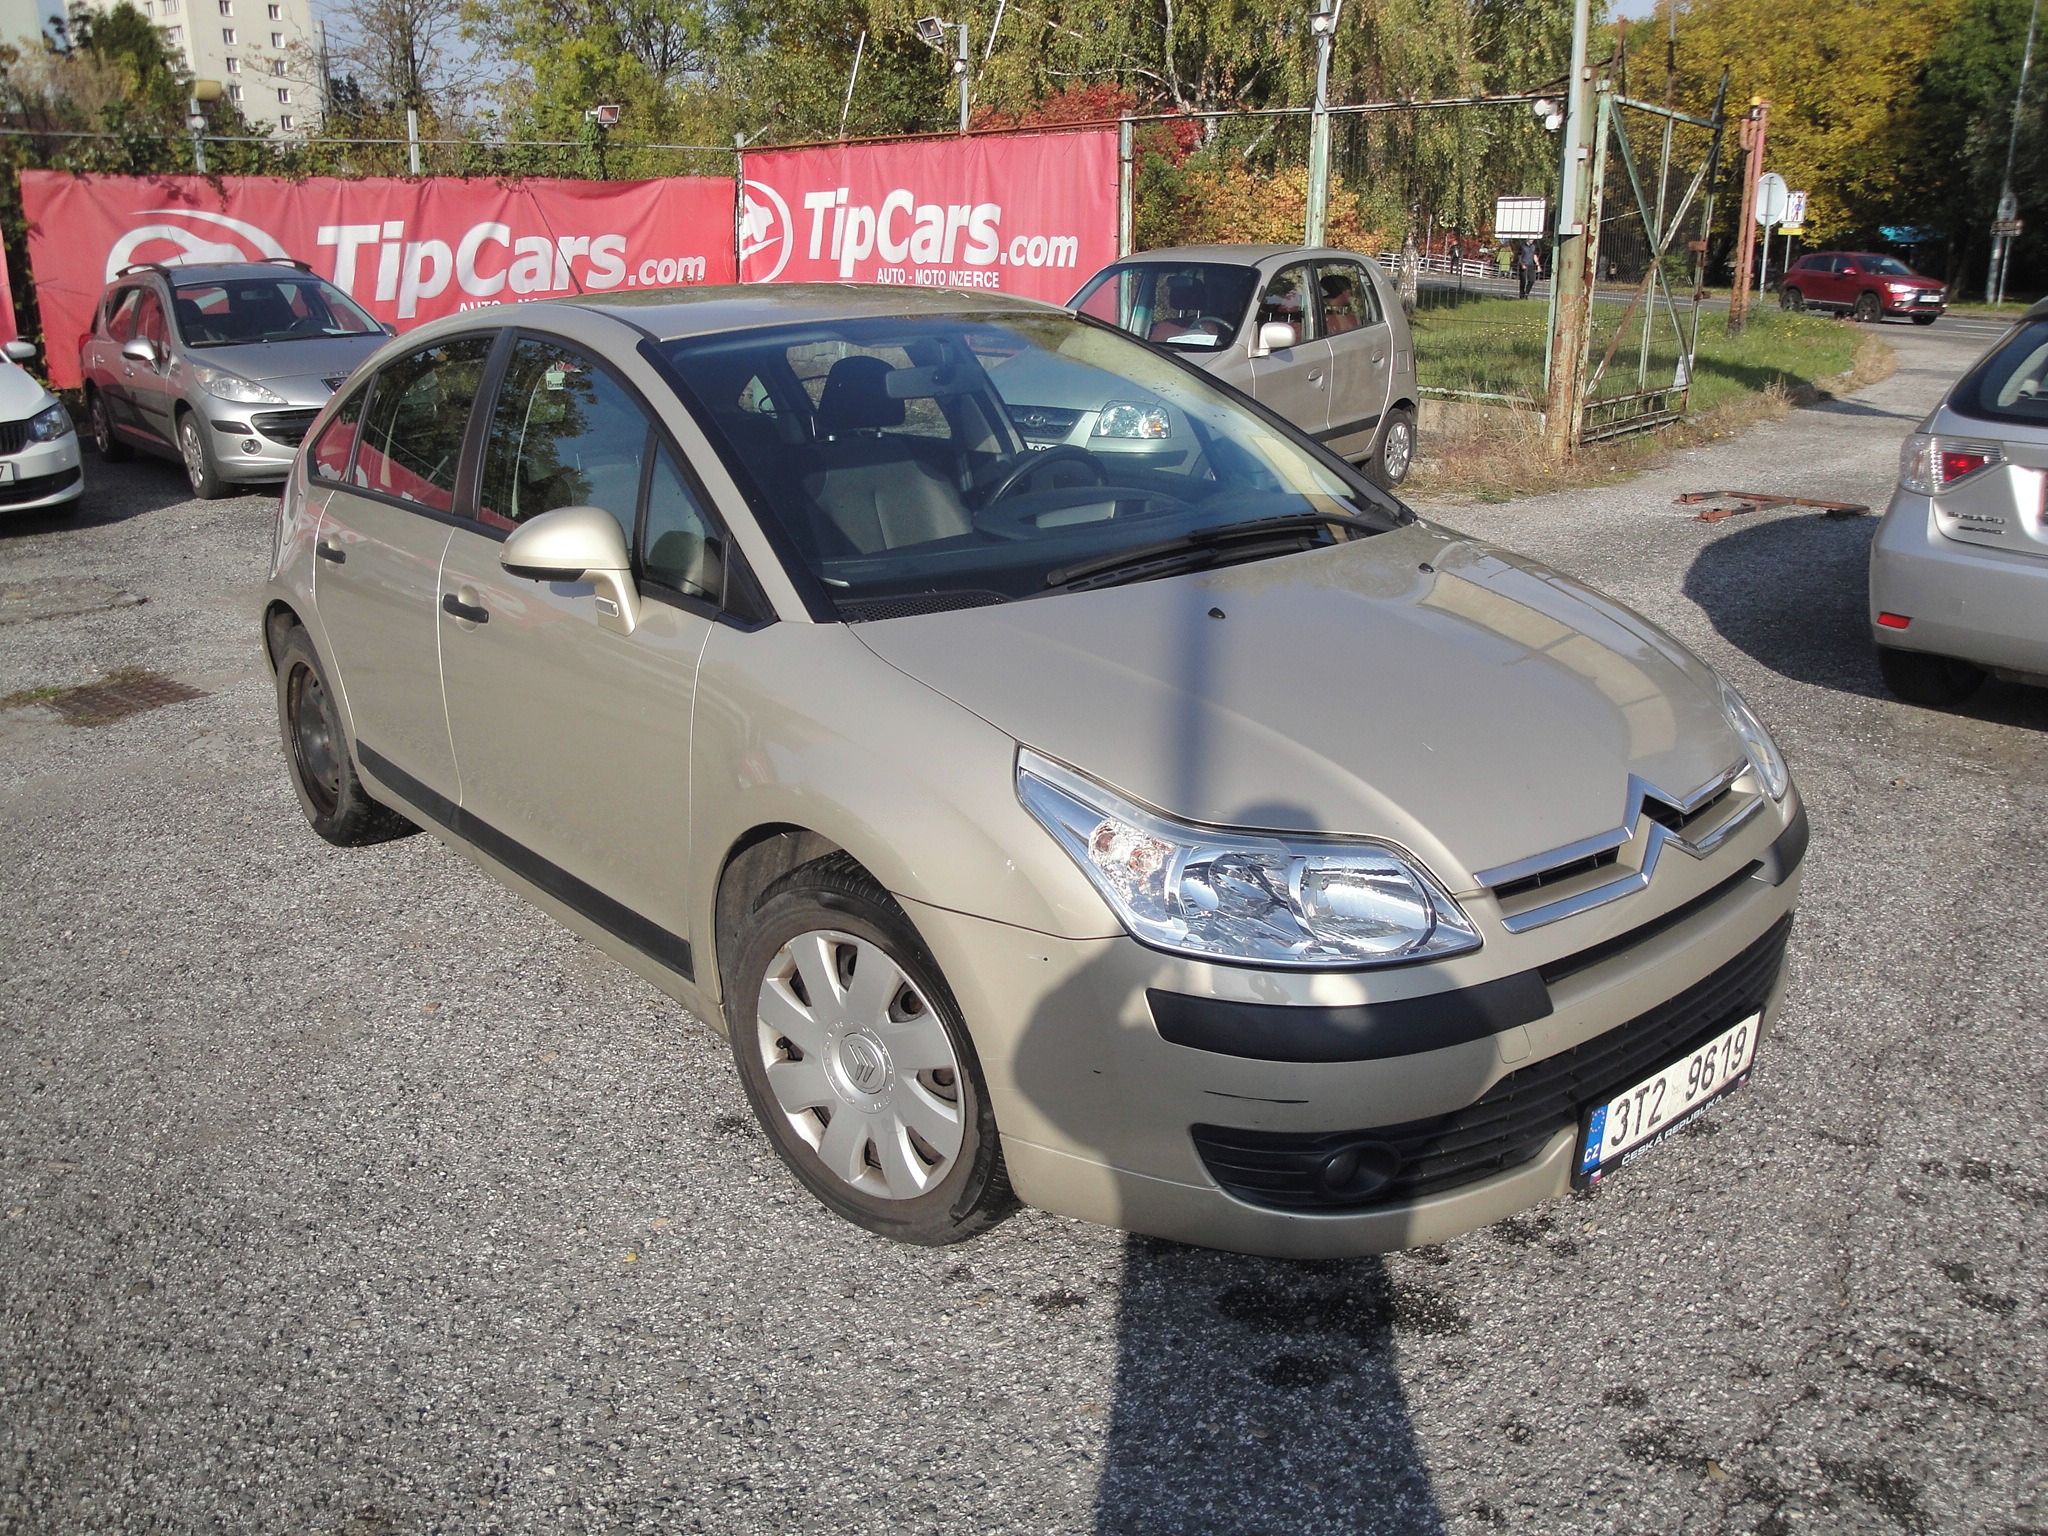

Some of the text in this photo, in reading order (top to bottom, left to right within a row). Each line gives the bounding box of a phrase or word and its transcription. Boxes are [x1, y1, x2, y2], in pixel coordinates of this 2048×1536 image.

[803, 187, 1079, 278] TipCars.com
[316, 220, 707, 319] TipCars.com
[877, 267, 906, 284] AUTO
[915, 269, 947, 286] MOTO
[949, 270, 1000, 288] INZERCE
[459, 300, 501, 313] AUT
[1610, 1025, 1748, 1147] 3T2 9619
[1584, 1143, 1600, 1163] CZ
[1621, 1094, 1723, 1166] ČESKÁ REPUBLIKA
